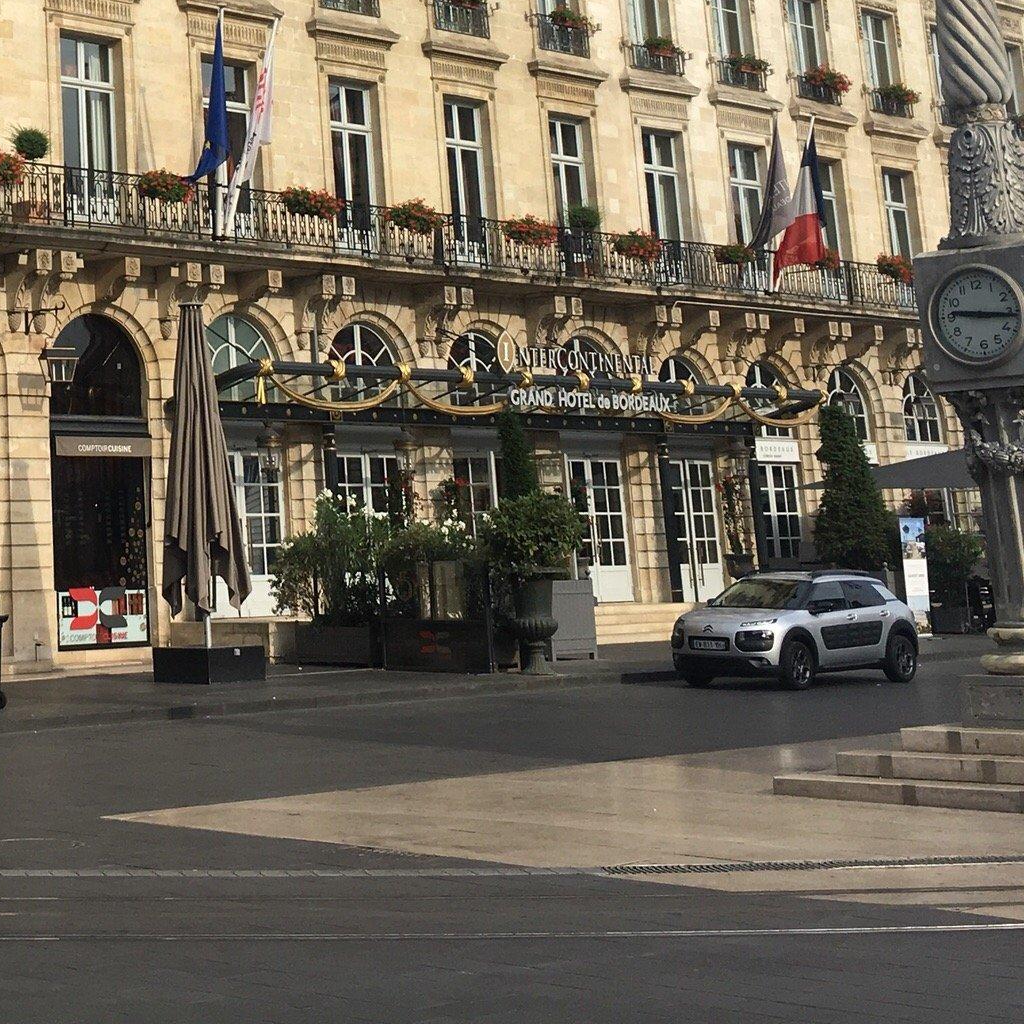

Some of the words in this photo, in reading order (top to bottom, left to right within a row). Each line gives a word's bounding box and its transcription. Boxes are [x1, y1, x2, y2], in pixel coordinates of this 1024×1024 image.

[970, 280, 982, 290] 12
[989, 282, 993, 292] 1
[959, 285, 966, 295] 11
[999, 292, 1008, 302] 2
[949, 298, 960, 307] 10
[1002, 322, 1011, 331] 4
[953, 327, 962, 336] 8
[965, 337, 973, 346] 7
[994, 335, 1002, 344] 5
[980, 340, 988, 349] 6
[510, 389, 553, 407] GRAND
[598, 394, 611, 409] de
[613, 394, 671, 412] BORDEAUX
